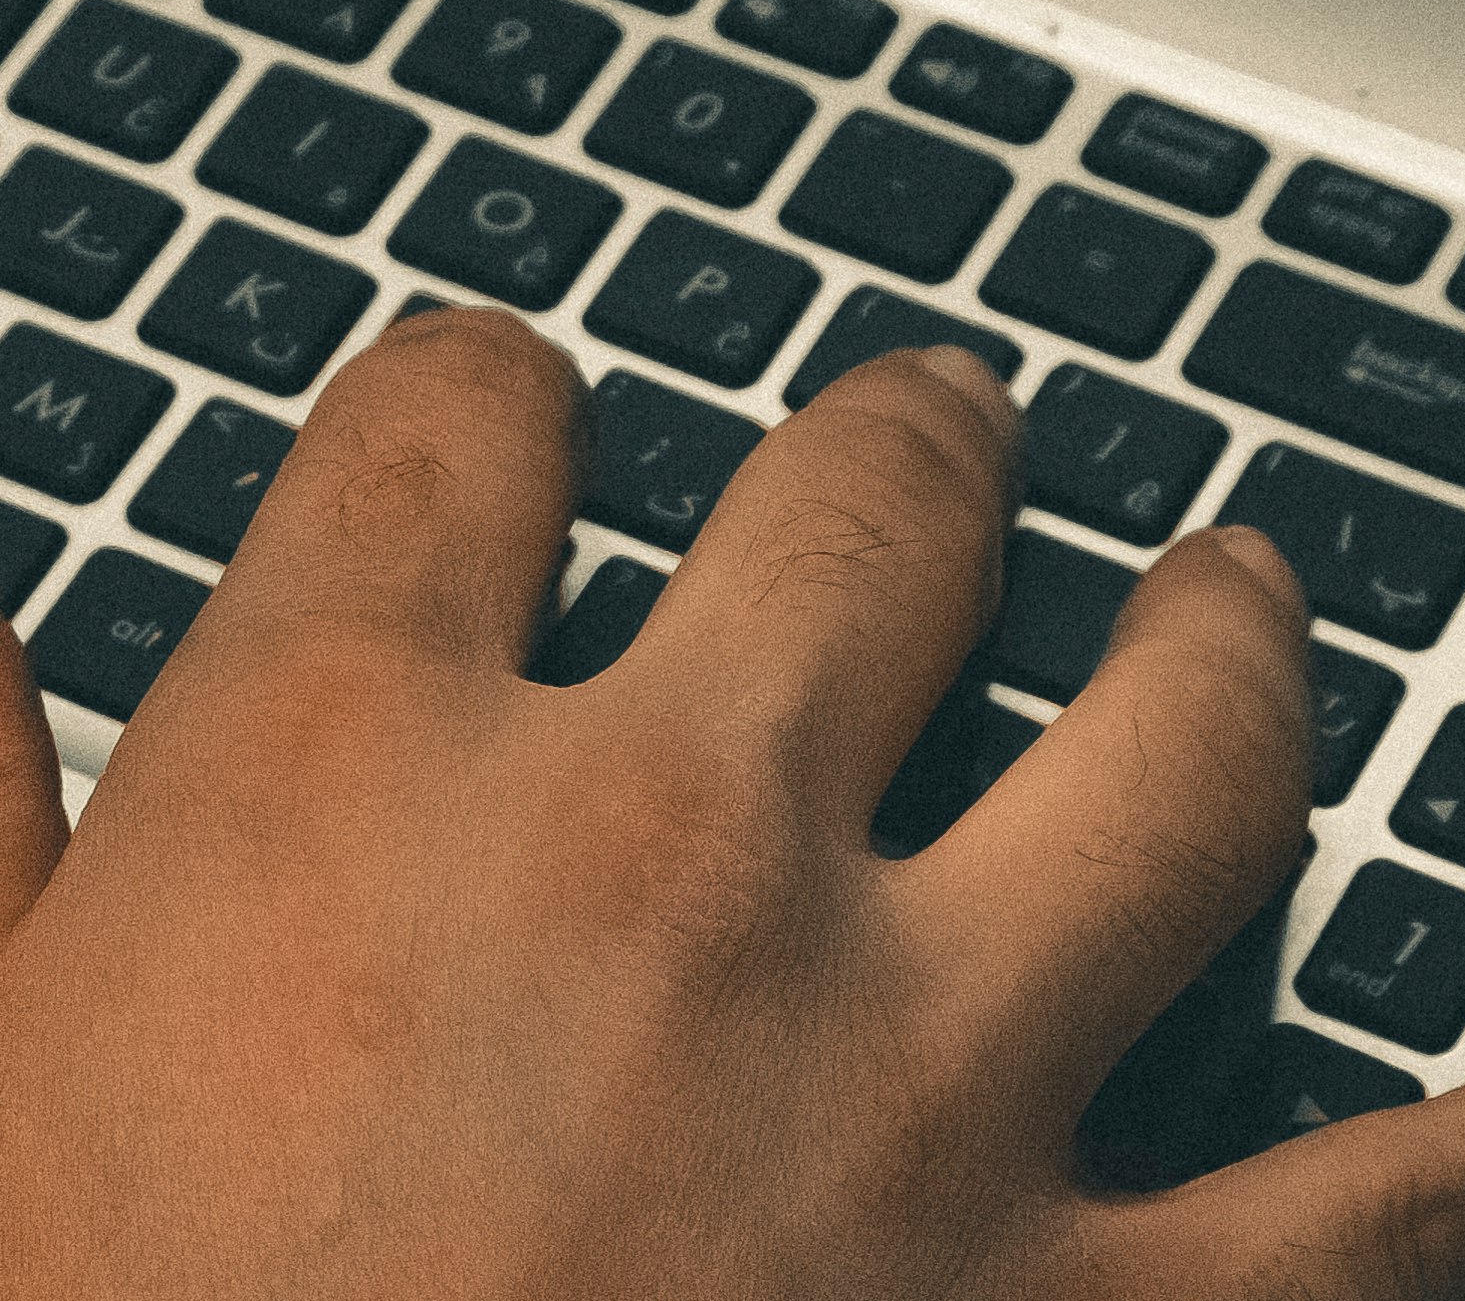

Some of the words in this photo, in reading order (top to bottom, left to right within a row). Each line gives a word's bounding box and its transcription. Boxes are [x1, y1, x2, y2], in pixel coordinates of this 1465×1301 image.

[489, 22, 530, 52] 9
[93, 46, 150, 86] U
[43, 208, 88, 242] J
[473, 191, 534, 233] O
[225, 274, 282, 318] K
[678, 266, 728, 300] P
[14, 382, 85, 429] M
[108, 610, 166, 654] alt
[1395, 922, 1429, 964] 1
